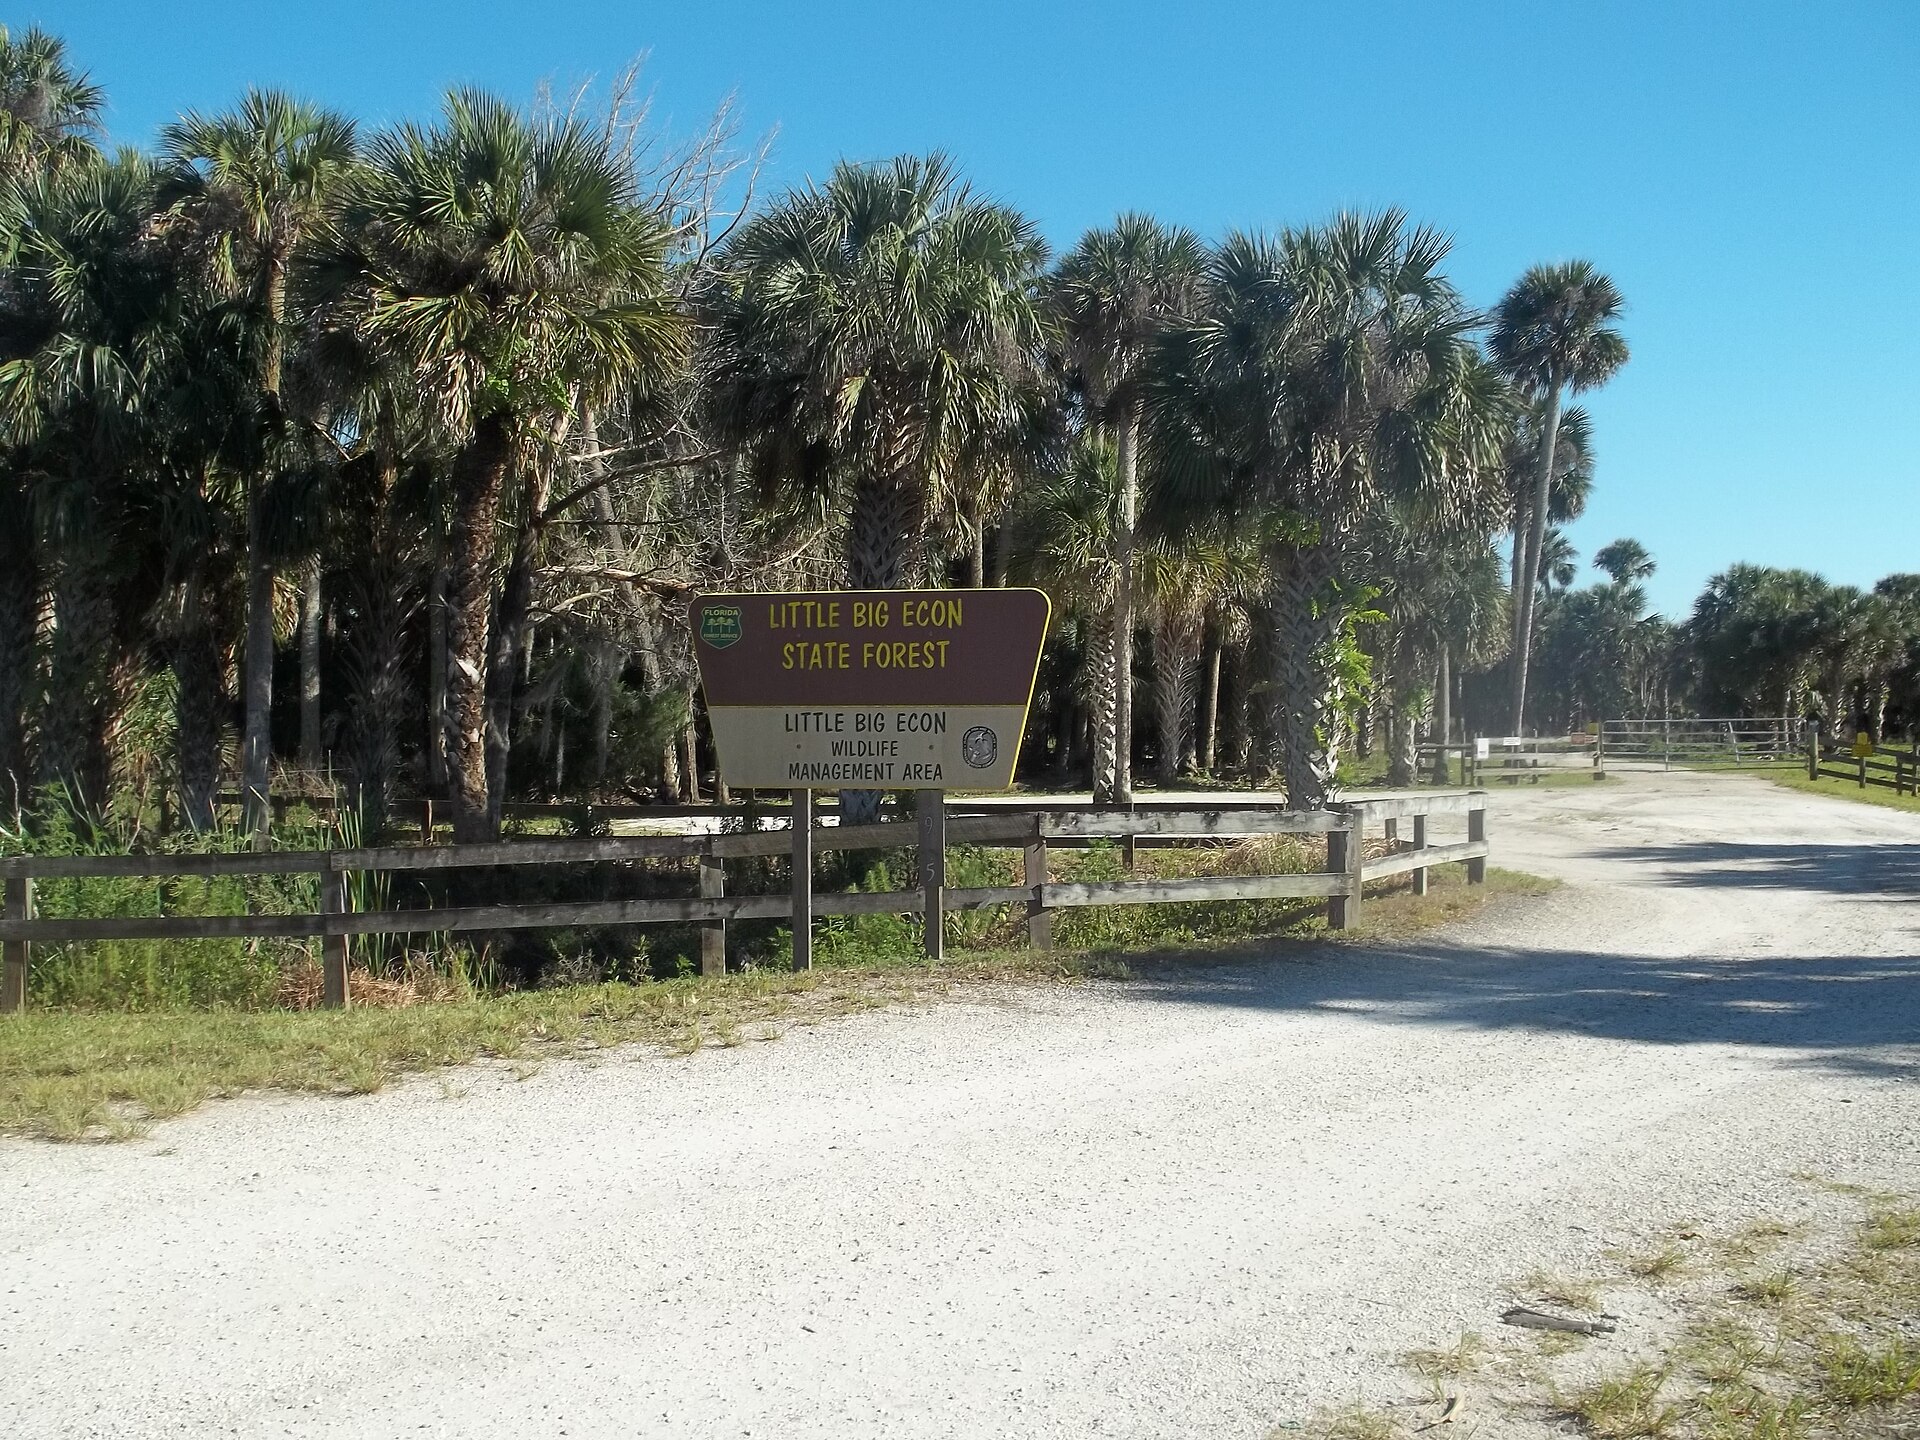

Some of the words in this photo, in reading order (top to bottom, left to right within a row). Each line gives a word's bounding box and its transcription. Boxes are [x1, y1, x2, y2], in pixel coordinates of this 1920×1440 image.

[769, 602, 840, 629] LITTLE
[852, 600, 889, 628] BIG
[902, 598, 963, 629] ECON
[781, 641, 851, 670] STATE
[862, 640, 950, 670] FOREST
[785, 712, 844, 733] LITTLE
[855, 712, 886, 733] BIG
[897, 711, 946, 733] ECON
[831, 740, 899, 757] WILDLIFE
[788, 762, 895, 781] MANAGEMENT
[902, 763, 943, 781] AREA
[926, 862, 935, 882] 5
